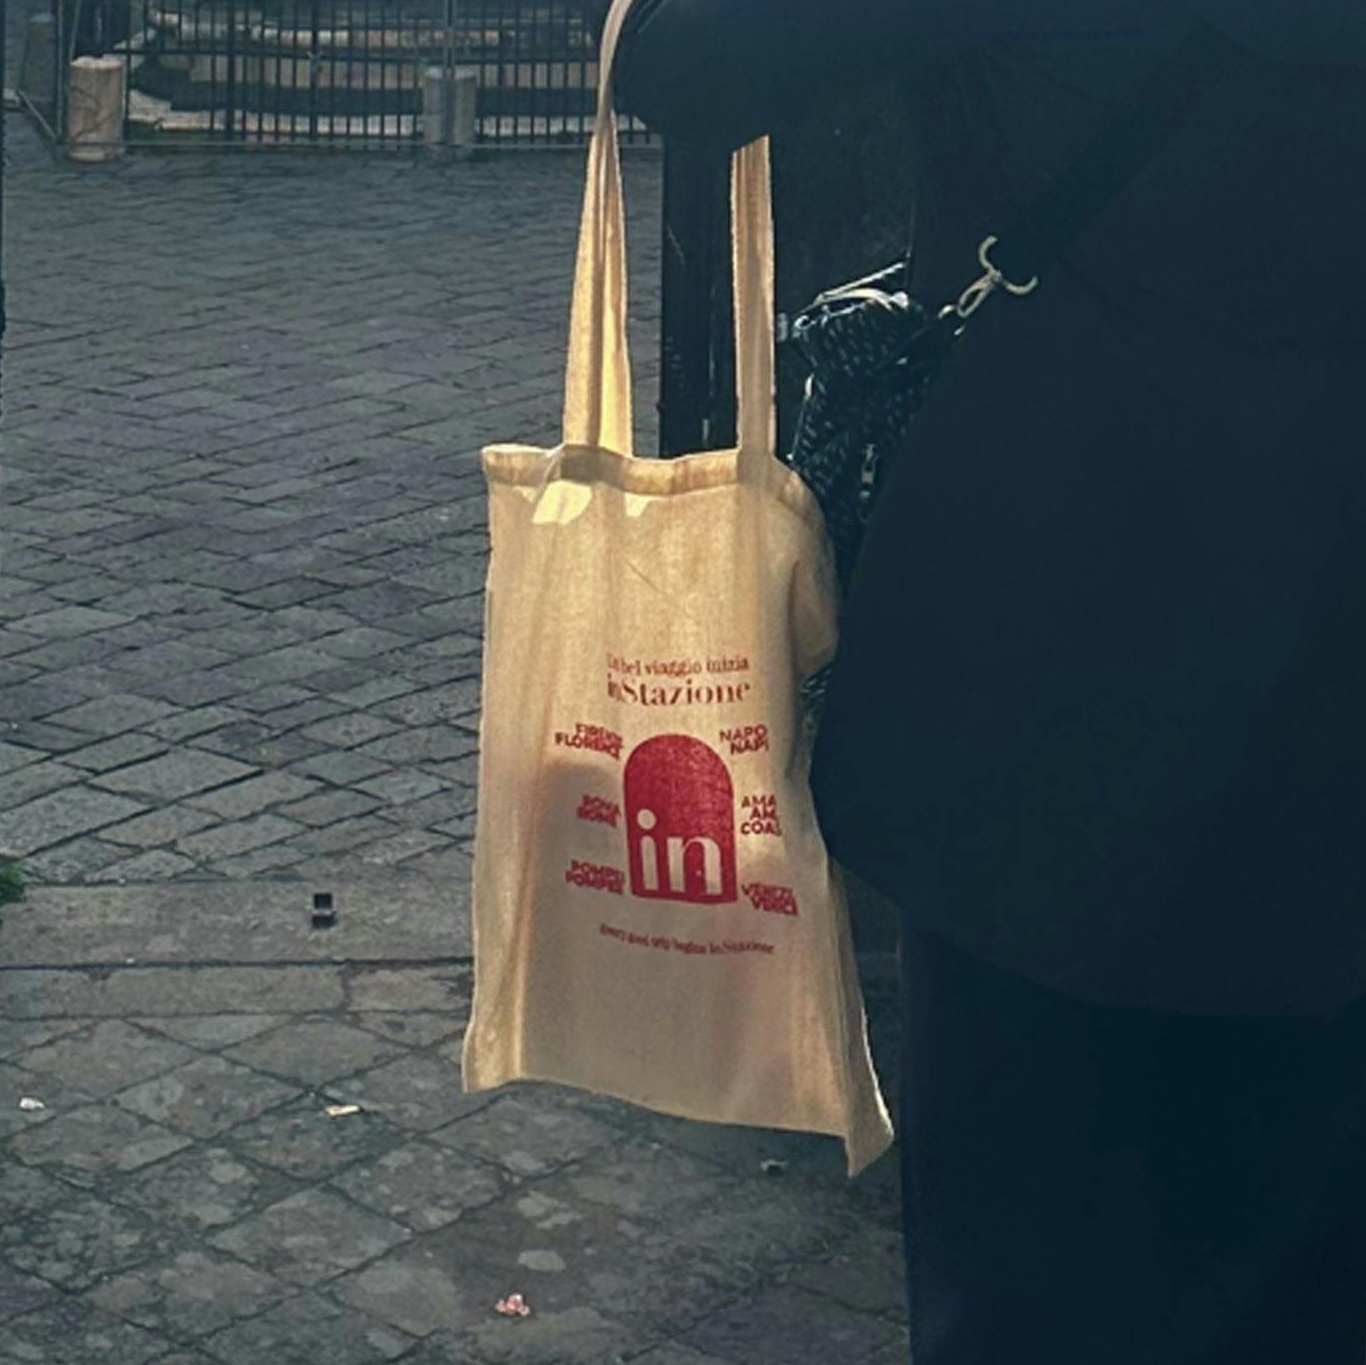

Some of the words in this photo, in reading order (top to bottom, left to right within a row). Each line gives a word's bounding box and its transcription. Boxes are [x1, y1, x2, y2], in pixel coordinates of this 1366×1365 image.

[645, 659, 702, 678] viaggio
[706, 655, 750, 673] inizia
[637, 808, 723, 896] in
